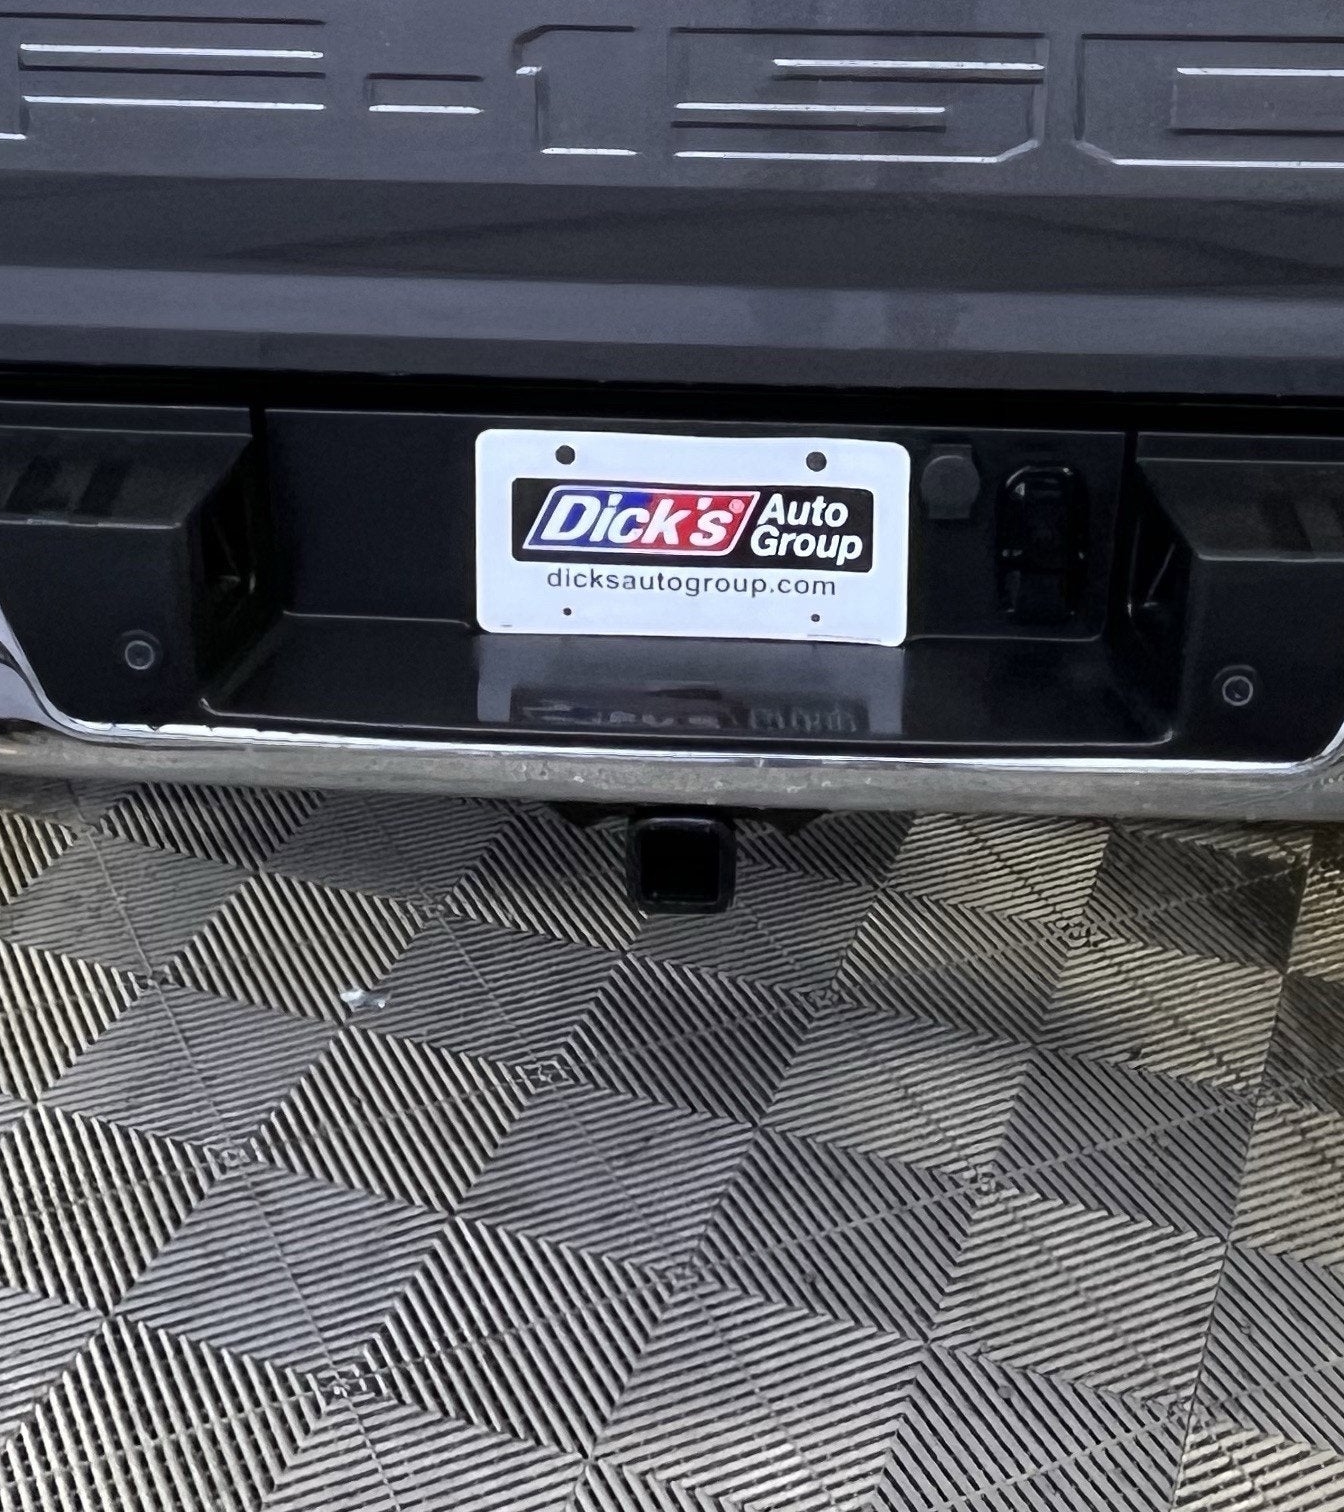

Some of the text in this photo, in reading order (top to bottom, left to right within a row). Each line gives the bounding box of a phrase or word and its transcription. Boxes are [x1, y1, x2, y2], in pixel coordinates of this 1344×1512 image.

[757, 492, 850, 529] Auto
[750, 525, 864, 567] Group
[546, 567, 837, 599] dicksautogroup.com
